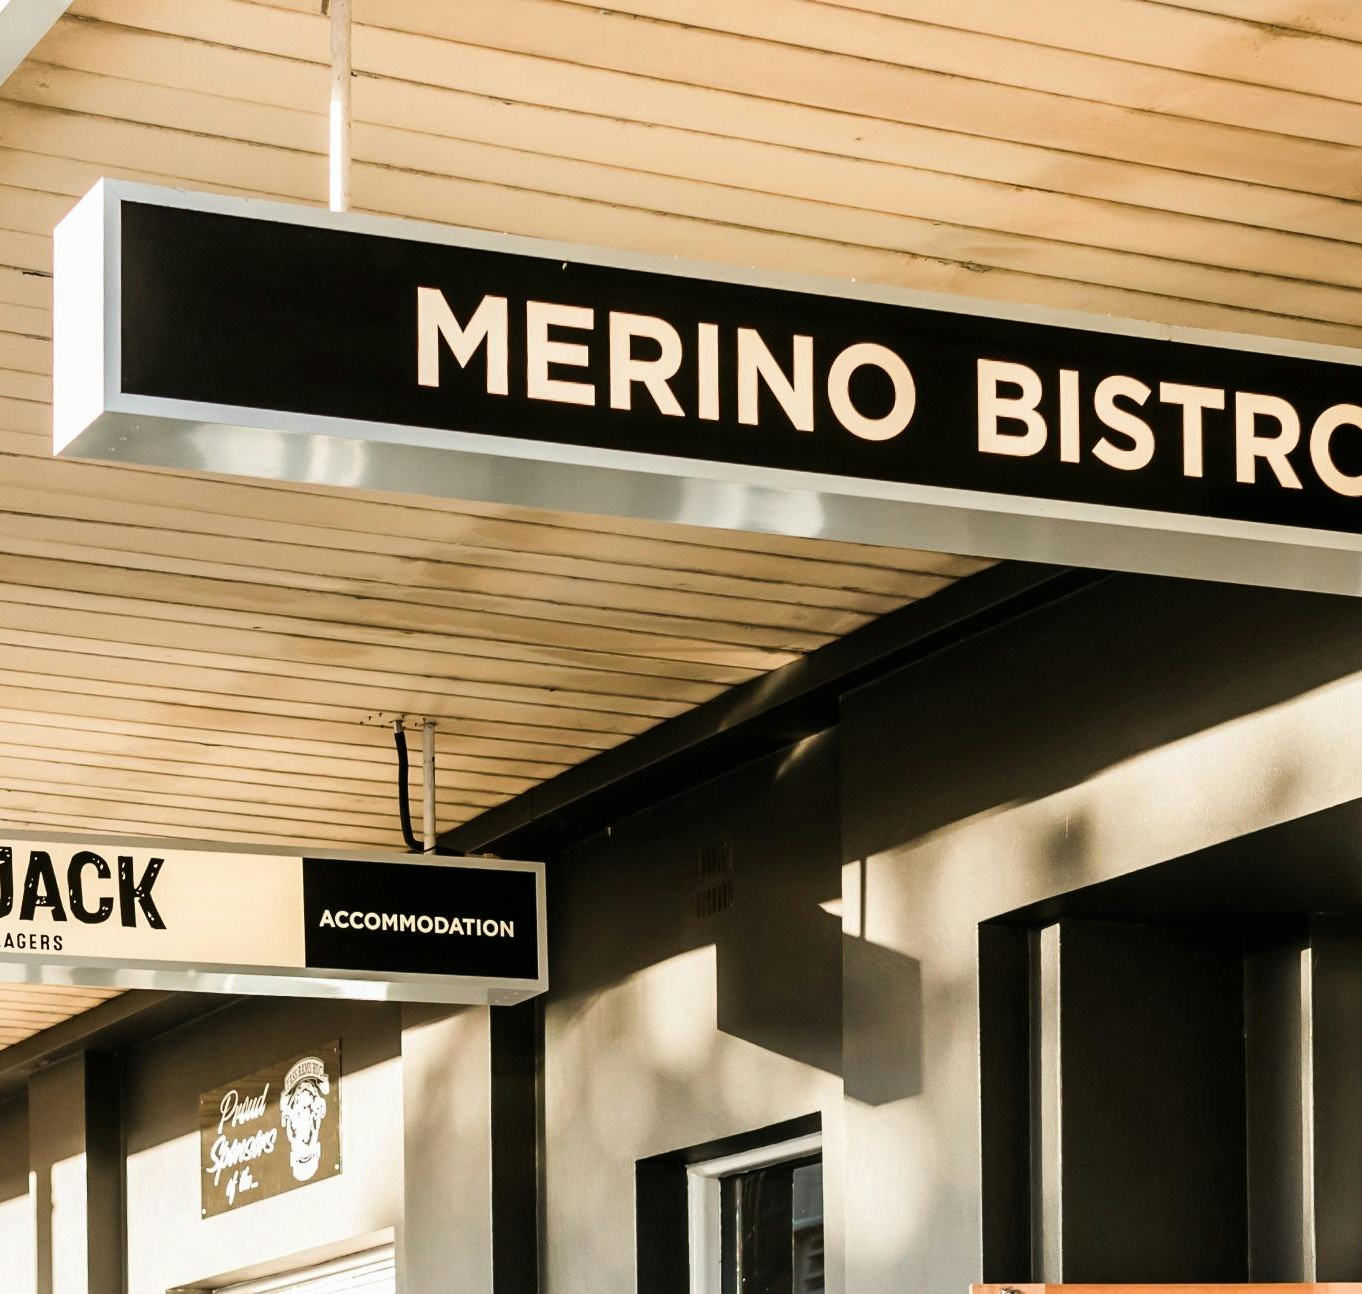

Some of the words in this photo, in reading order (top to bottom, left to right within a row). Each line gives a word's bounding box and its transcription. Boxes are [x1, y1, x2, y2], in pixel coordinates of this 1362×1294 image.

[416, 285, 916, 442] MERINO
[318, 908, 516, 938] ACCOMMODATION
[218, 1083, 270, 1134] Proud
[206, 1128, 278, 1186] Sponsors
